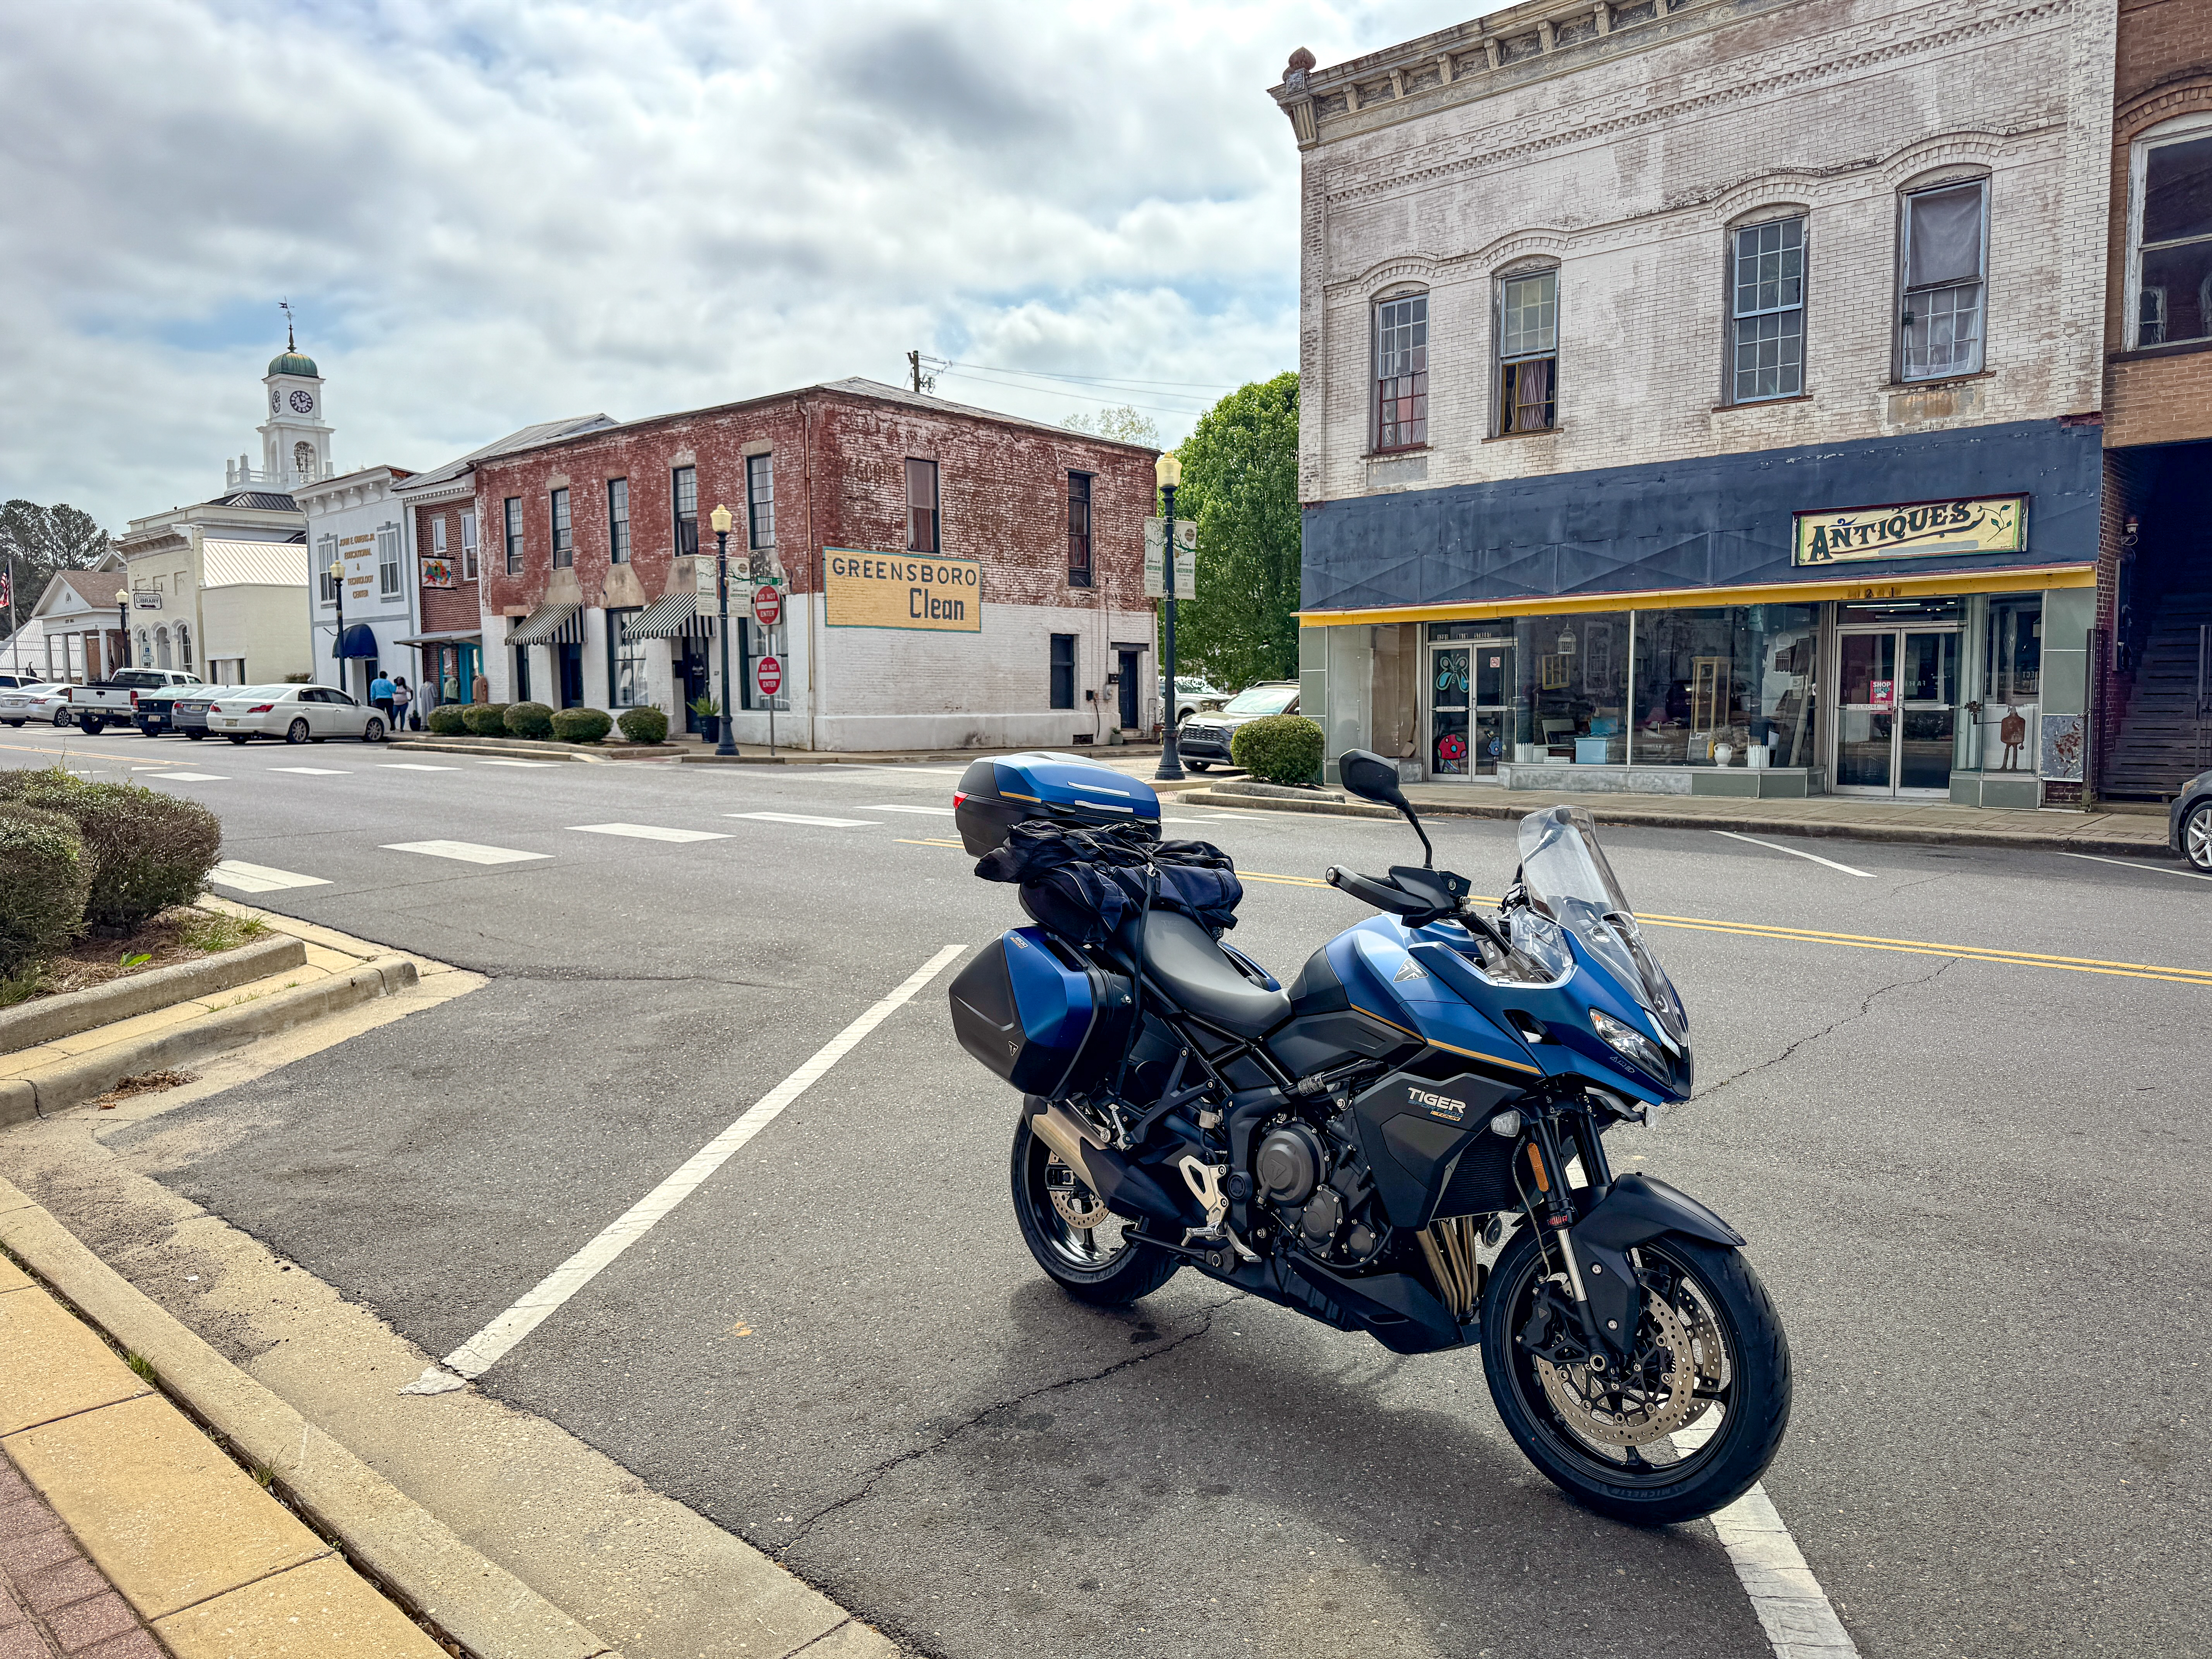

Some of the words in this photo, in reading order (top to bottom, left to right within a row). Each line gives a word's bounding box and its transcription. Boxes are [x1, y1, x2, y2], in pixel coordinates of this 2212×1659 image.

[1808, 500, 1972, 562] ANTIQUES
[344, 548, 372, 560] EDUCATIONAL
[832, 557, 977, 586] GREENSBORO
[347, 575, 373, 586] TECHNOLOGY
[353, 589, 368, 599] CENTER
[909, 587, 964, 620] Clean
[1015, 937, 1029, 948] 800
[1408, 1087, 1466, 1114] TIGER
[1408, 1099, 1443, 1111] SPORT
[1444, 1109, 1464, 1118] 800
[1437, 1113, 1459, 1121] TOUR
